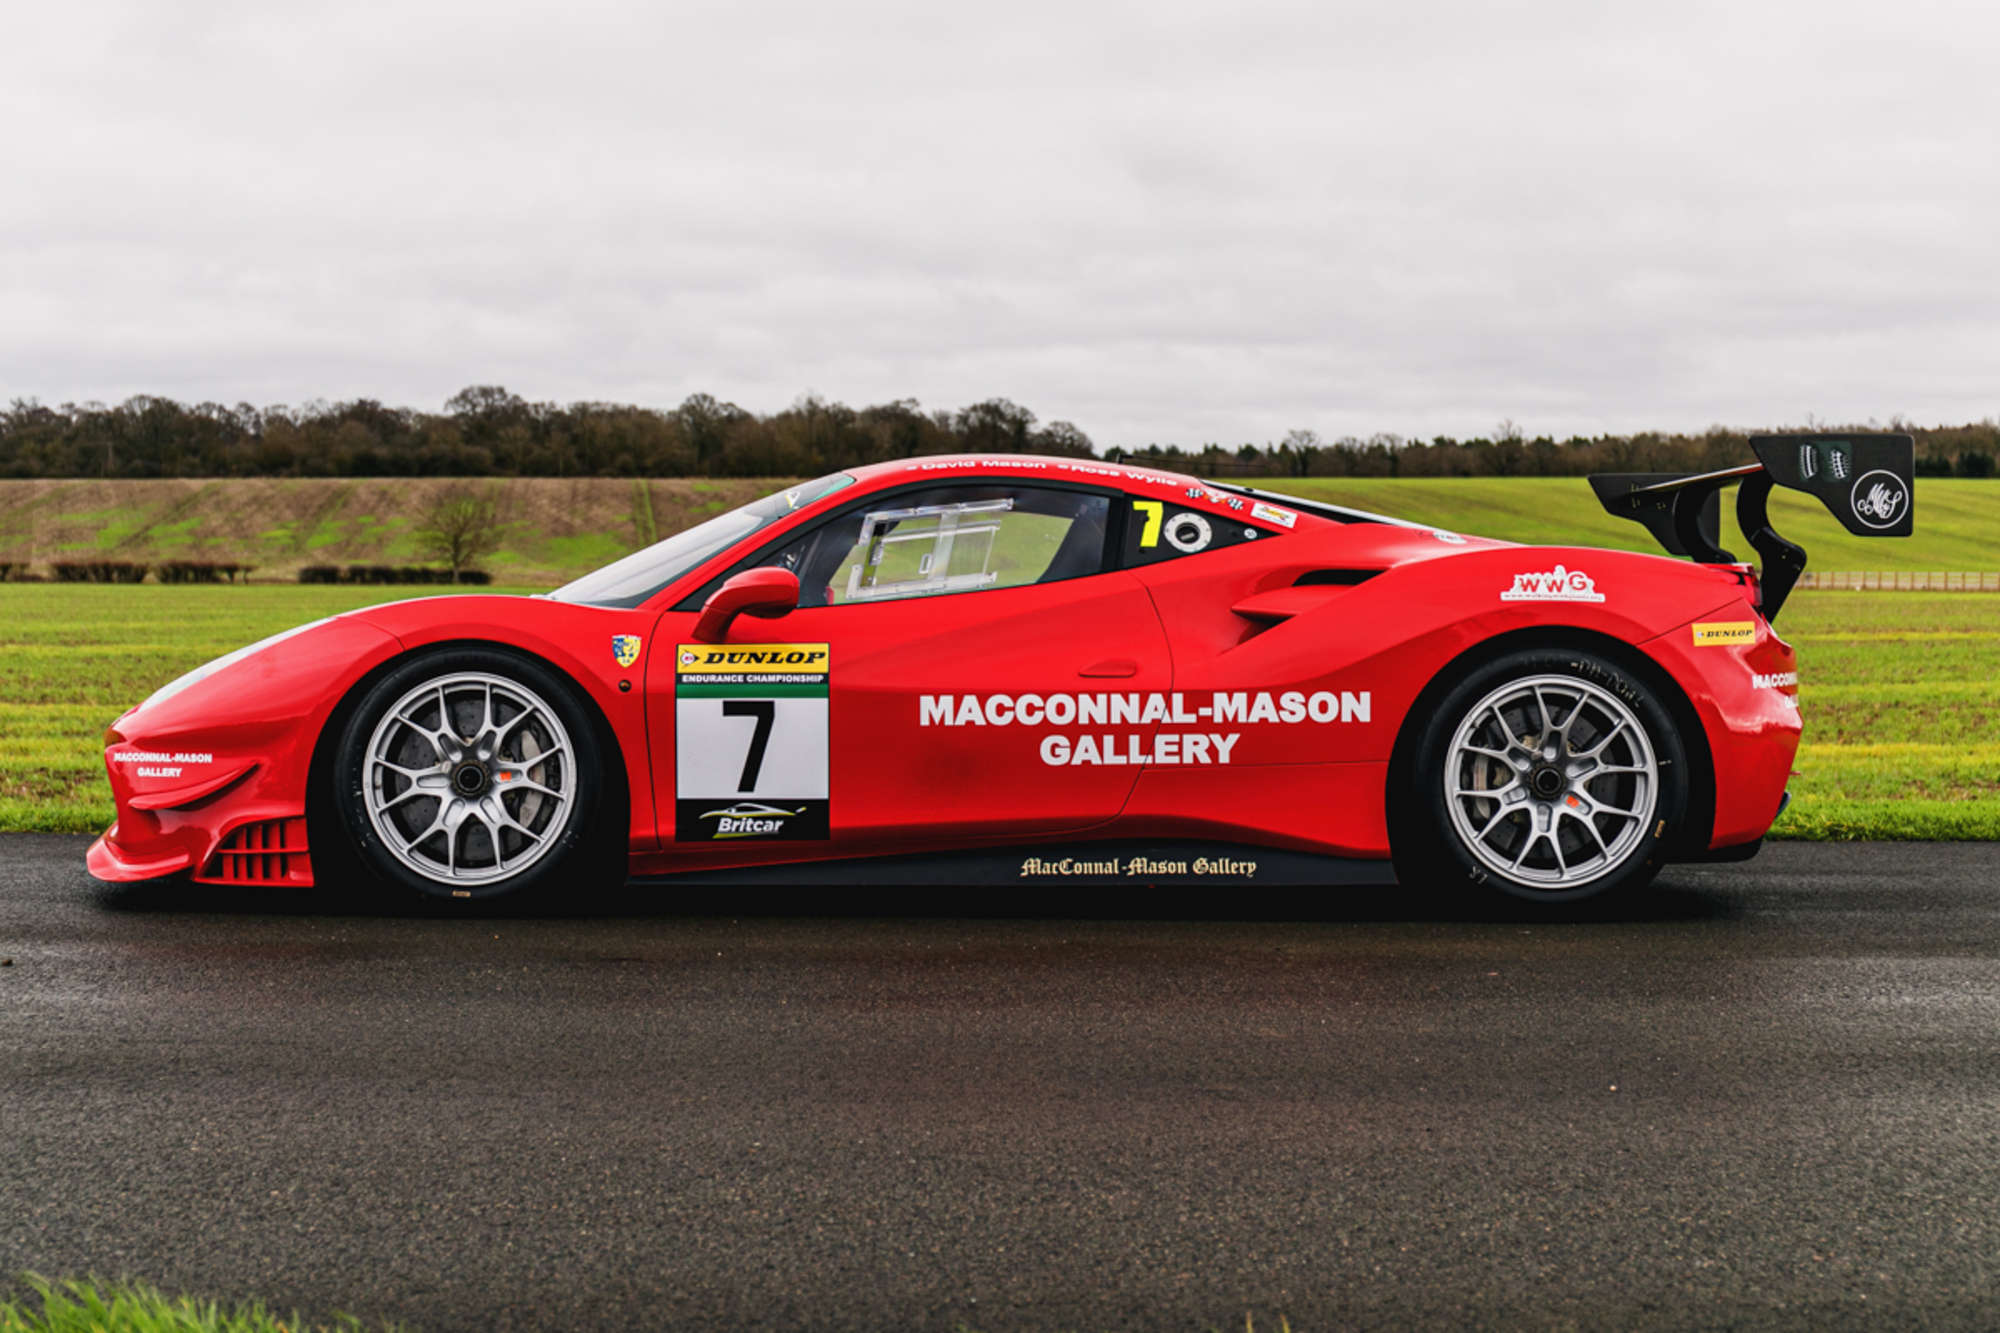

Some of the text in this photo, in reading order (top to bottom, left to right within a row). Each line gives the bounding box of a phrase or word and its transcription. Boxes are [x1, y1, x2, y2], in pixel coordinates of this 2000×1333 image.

[982, 460, 1047, 469] Mason
[1133, 501, 1163, 548] 7
[1518, 573, 1587, 593] WWG
[1706, 629, 1753, 638] DUNLOP
[703, 652, 826, 664] DUNLOP
[681, 674, 825, 683] ENDURANCE CHAMPIONSHIP
[919, 691, 1371, 726] MACCONNAL-MASON
[722, 700, 776, 793] 7
[1039, 733, 1240, 766] GALLERY
[113, 751, 213, 764] MACCONNAL-MASON
[136, 766, 183, 778] GALLERY
[717, 817, 784, 833] Britcar
[1192, 857, 1257, 878] Gallery
